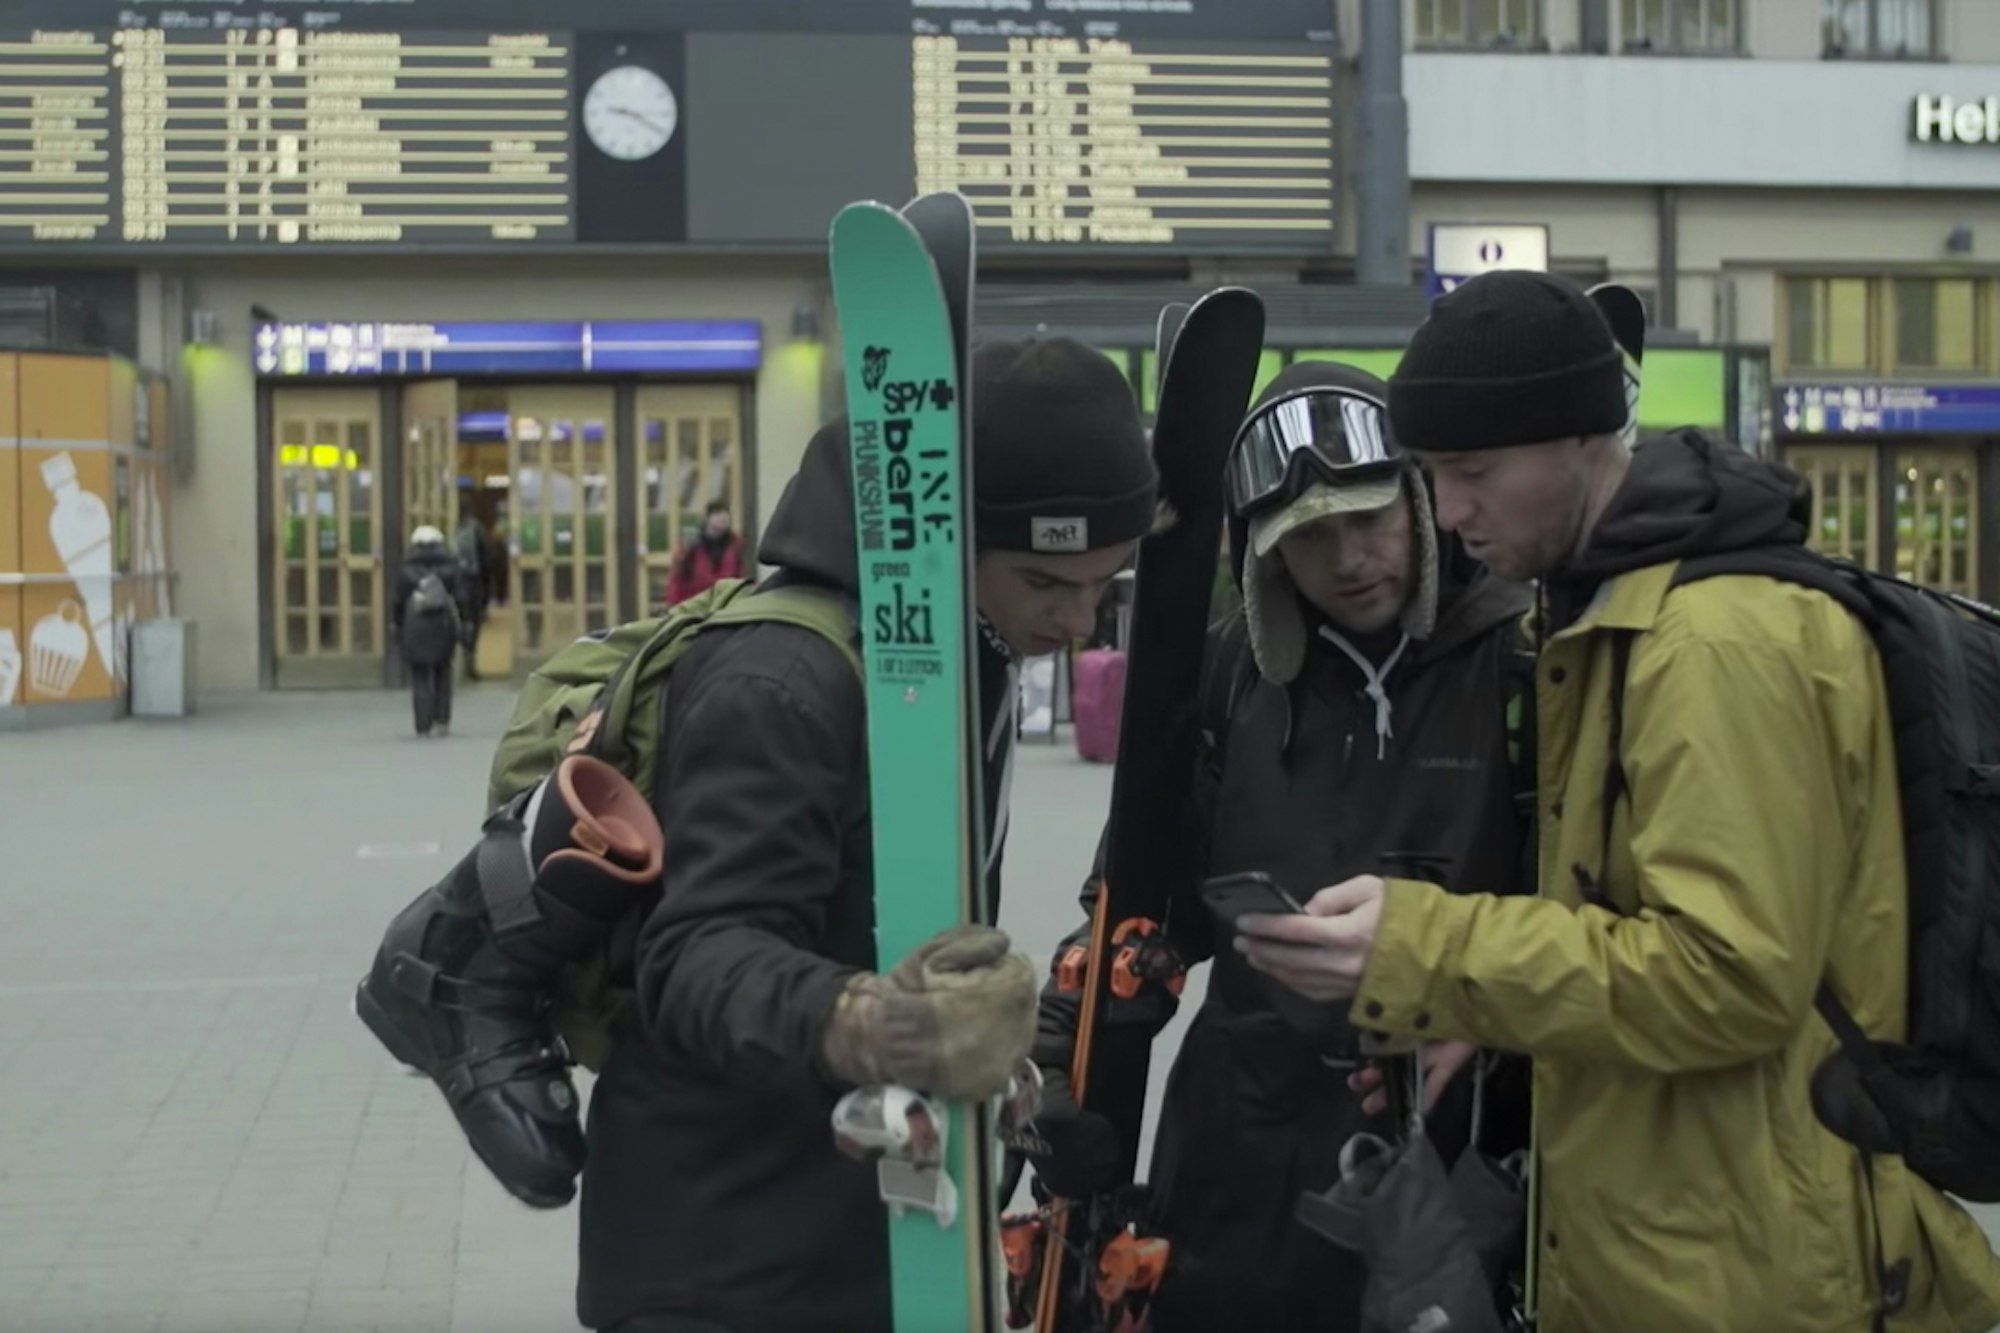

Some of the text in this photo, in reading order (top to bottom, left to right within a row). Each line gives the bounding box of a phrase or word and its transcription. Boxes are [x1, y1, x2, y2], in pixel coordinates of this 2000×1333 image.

[884, 418, 916, 551] bern
[872, 562, 910, 583] green
[875, 583, 934, 645] ski
